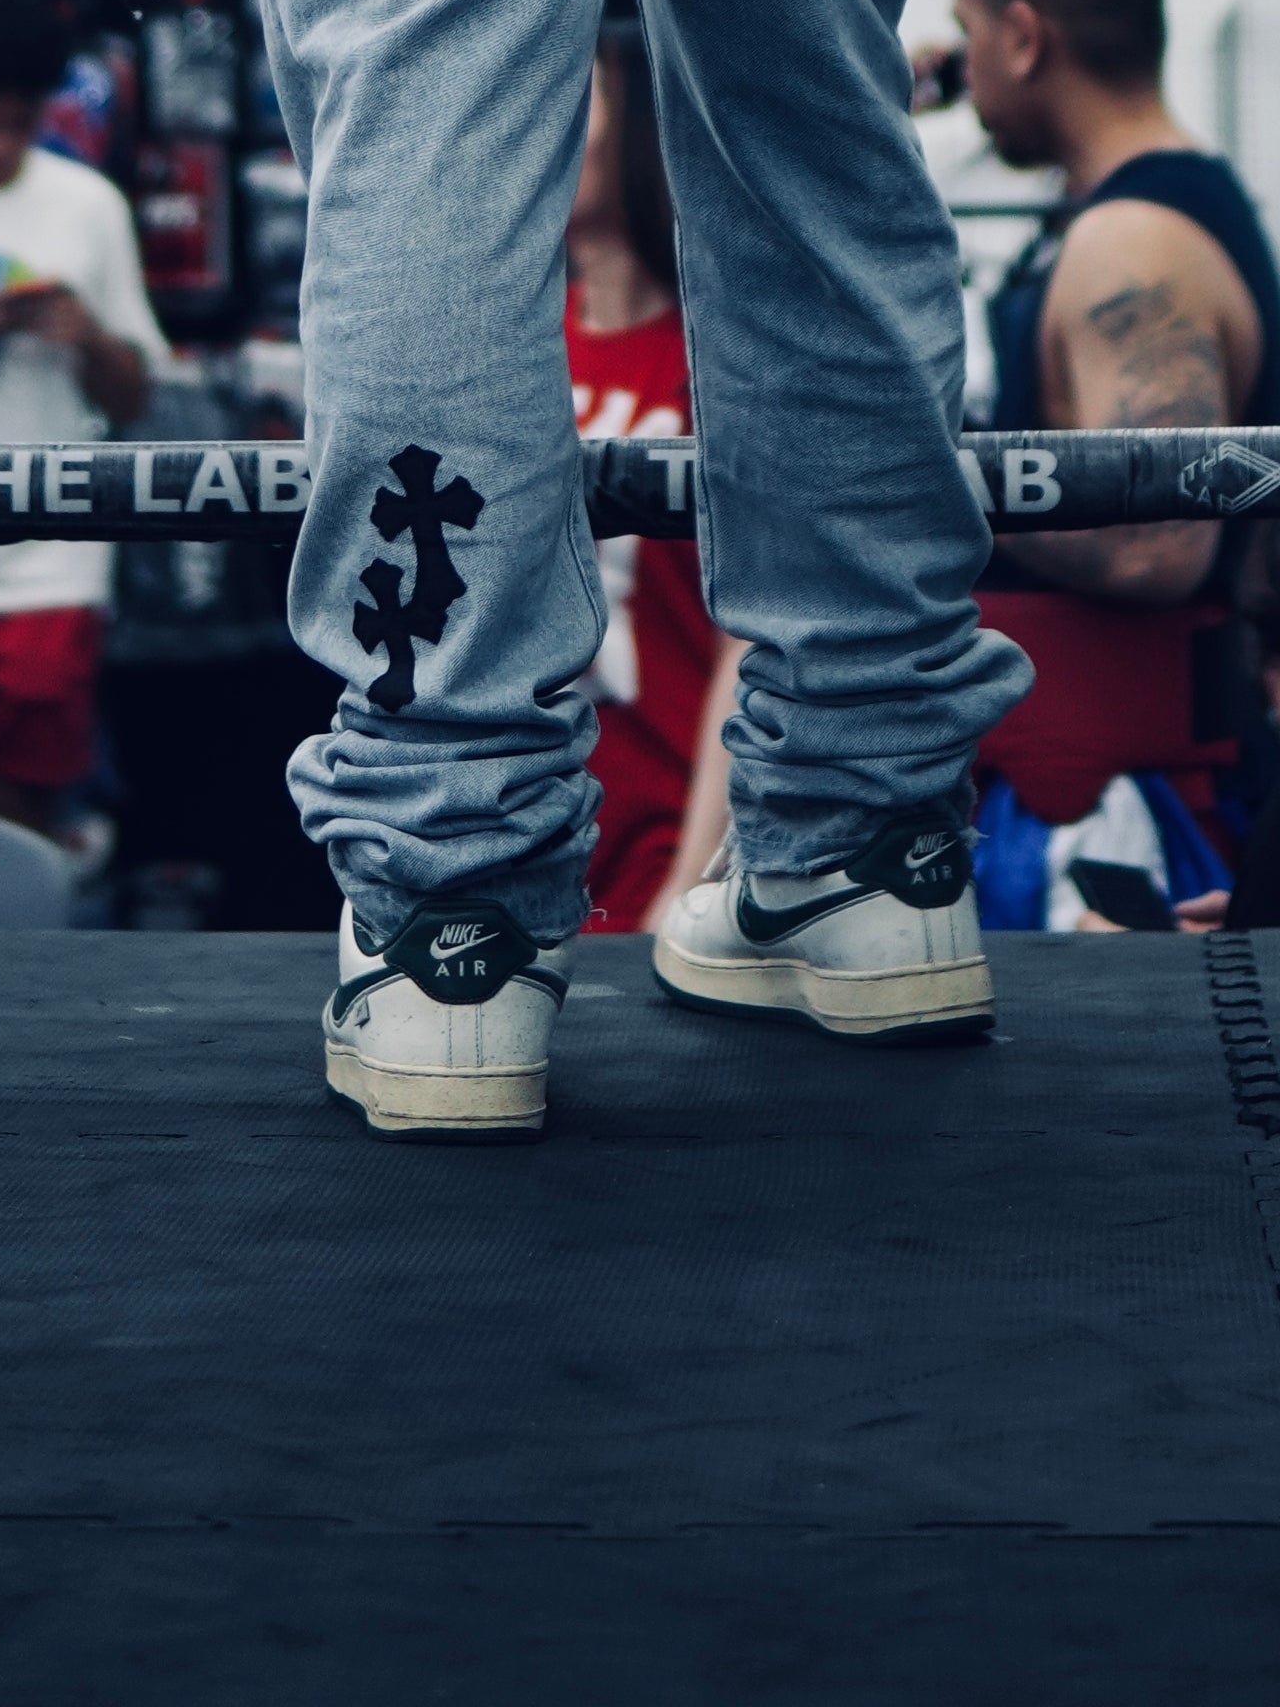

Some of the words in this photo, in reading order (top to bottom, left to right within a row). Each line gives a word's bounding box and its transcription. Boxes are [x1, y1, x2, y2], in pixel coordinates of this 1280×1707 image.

[134, 449, 310, 514] LAB
[913, 832, 948, 853] NIKE
[911, 865, 952, 885] AIR
[439, 923, 484, 944] NIKE
[434, 960, 486, 977] AIR
